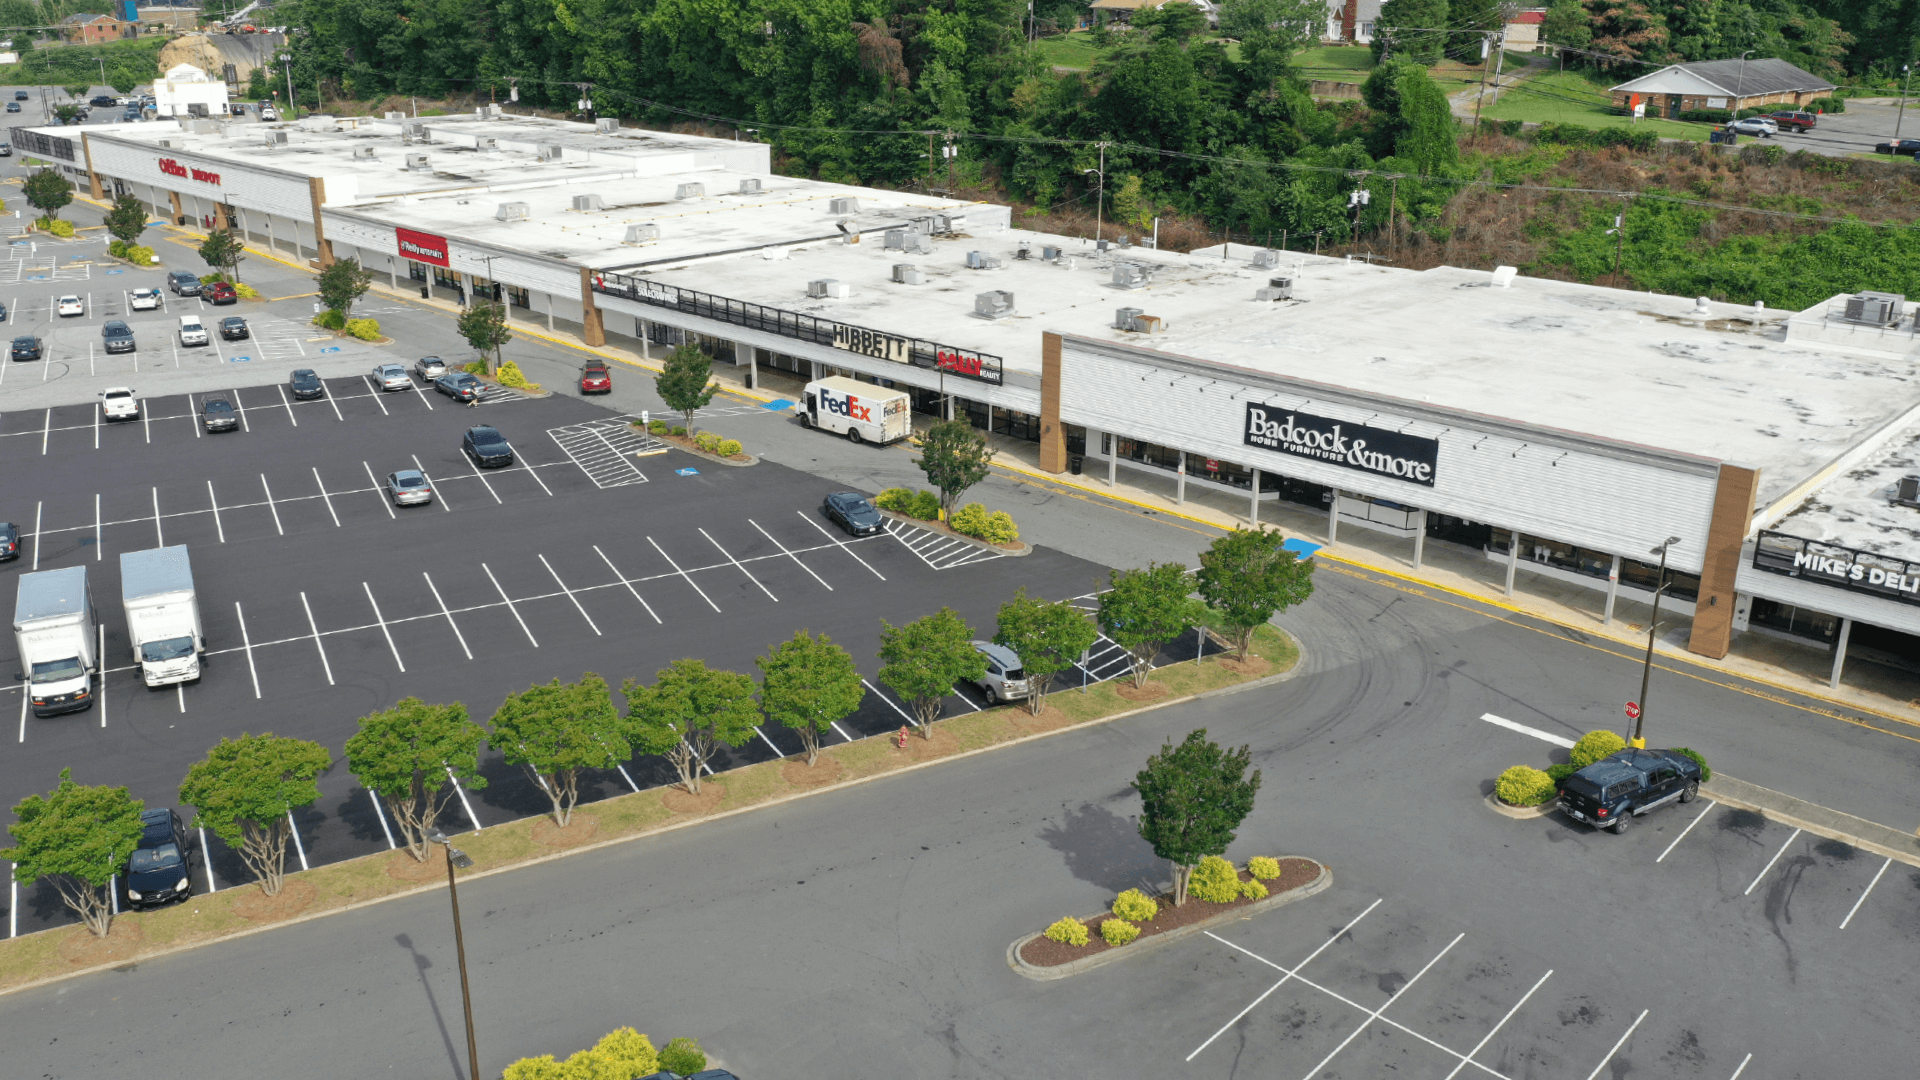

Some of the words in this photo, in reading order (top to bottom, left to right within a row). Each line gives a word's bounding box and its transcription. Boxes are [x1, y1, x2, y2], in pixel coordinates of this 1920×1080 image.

[833, 324, 906, 357] HIBBETT
[938, 351, 982, 376] SALLY
[980, 370, 1000, 380] BEAUTY
[820, 388, 871, 422] FedEx
[883, 402, 907, 417] FedEx
[1251, 435, 1278, 447] HOME
[1283, 442, 1344, 462] FURNITURE
[1793, 551, 1864, 580] MIKE'S
[1868, 567, 1920, 593] DELI
[1625, 705, 1639, 715] STOP
